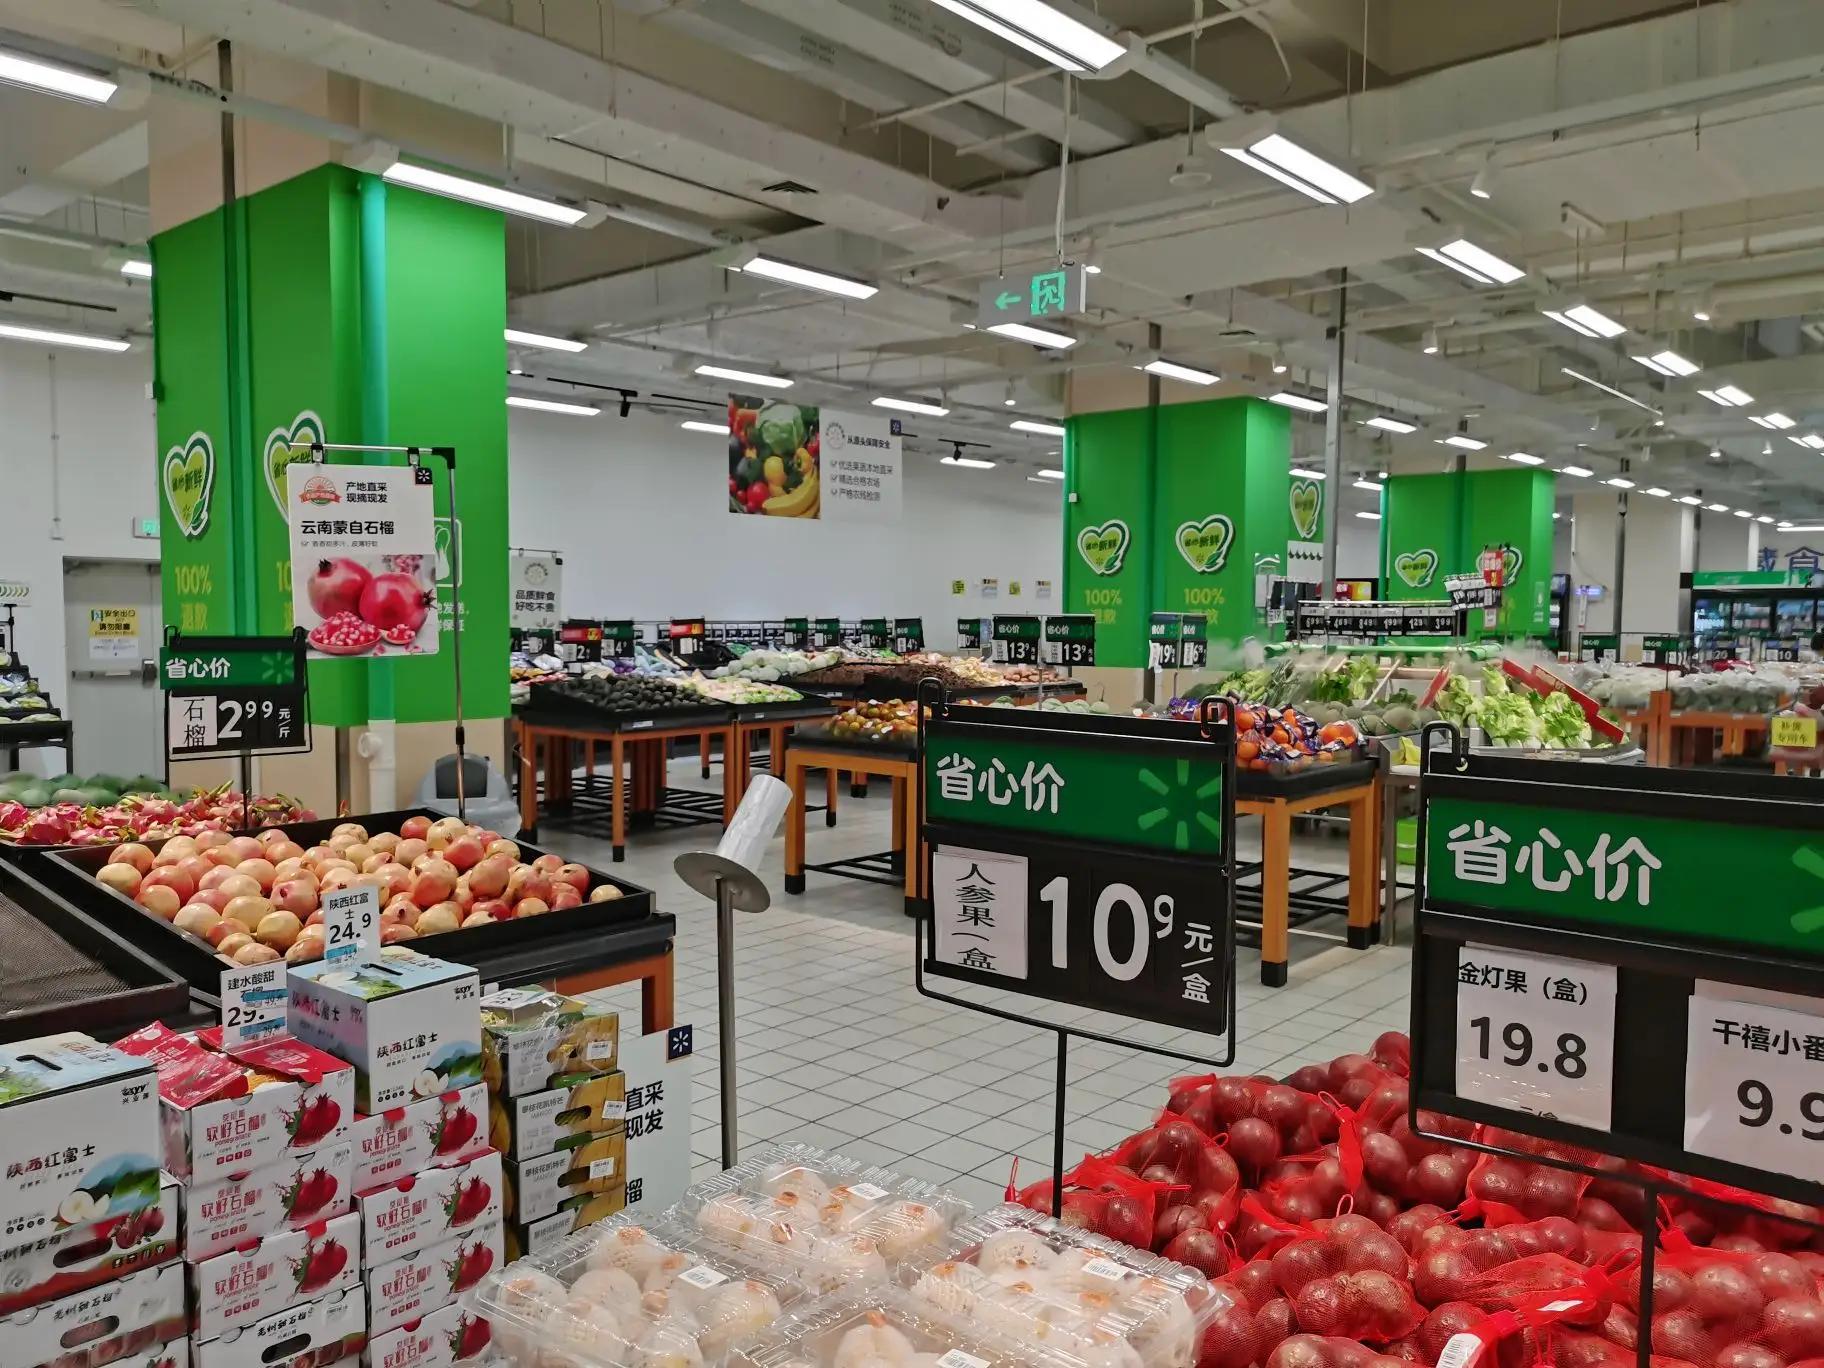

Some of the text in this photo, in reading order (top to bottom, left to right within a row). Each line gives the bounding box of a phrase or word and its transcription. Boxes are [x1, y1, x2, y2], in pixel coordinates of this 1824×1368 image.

[346, 482, 388, 492] 产地直采
[346, 493, 388, 504] 现摘现发
[301, 520, 394, 535] 云南蒙自石榴
[174, 565, 212, 595] 100%
[1084, 589, 1122, 605] 100%
[1184, 588, 1224, 604] 100%
[165, 657, 231, 679] 省心价
[183, 698, 206, 747] 石榴
[936, 752, 1065, 814] 省心价
[1446, 819, 1662, 906] 省心价
[329, 892, 369, 910] 陕西红富
[344, 908, 355, 920] 士
[329, 913, 371, 944] 24.9
[951, 863, 996, 971] 人参果一盒
[227, 970, 275, 990] 建水酸甜
[377, 1032, 438, 1059] 陕西红富士
[1470, 1015, 1588, 1080] 19.8
[206, 1114, 260, 1143] 软籽石榴
[6, 1144, 96, 1179] 陕西红富士
